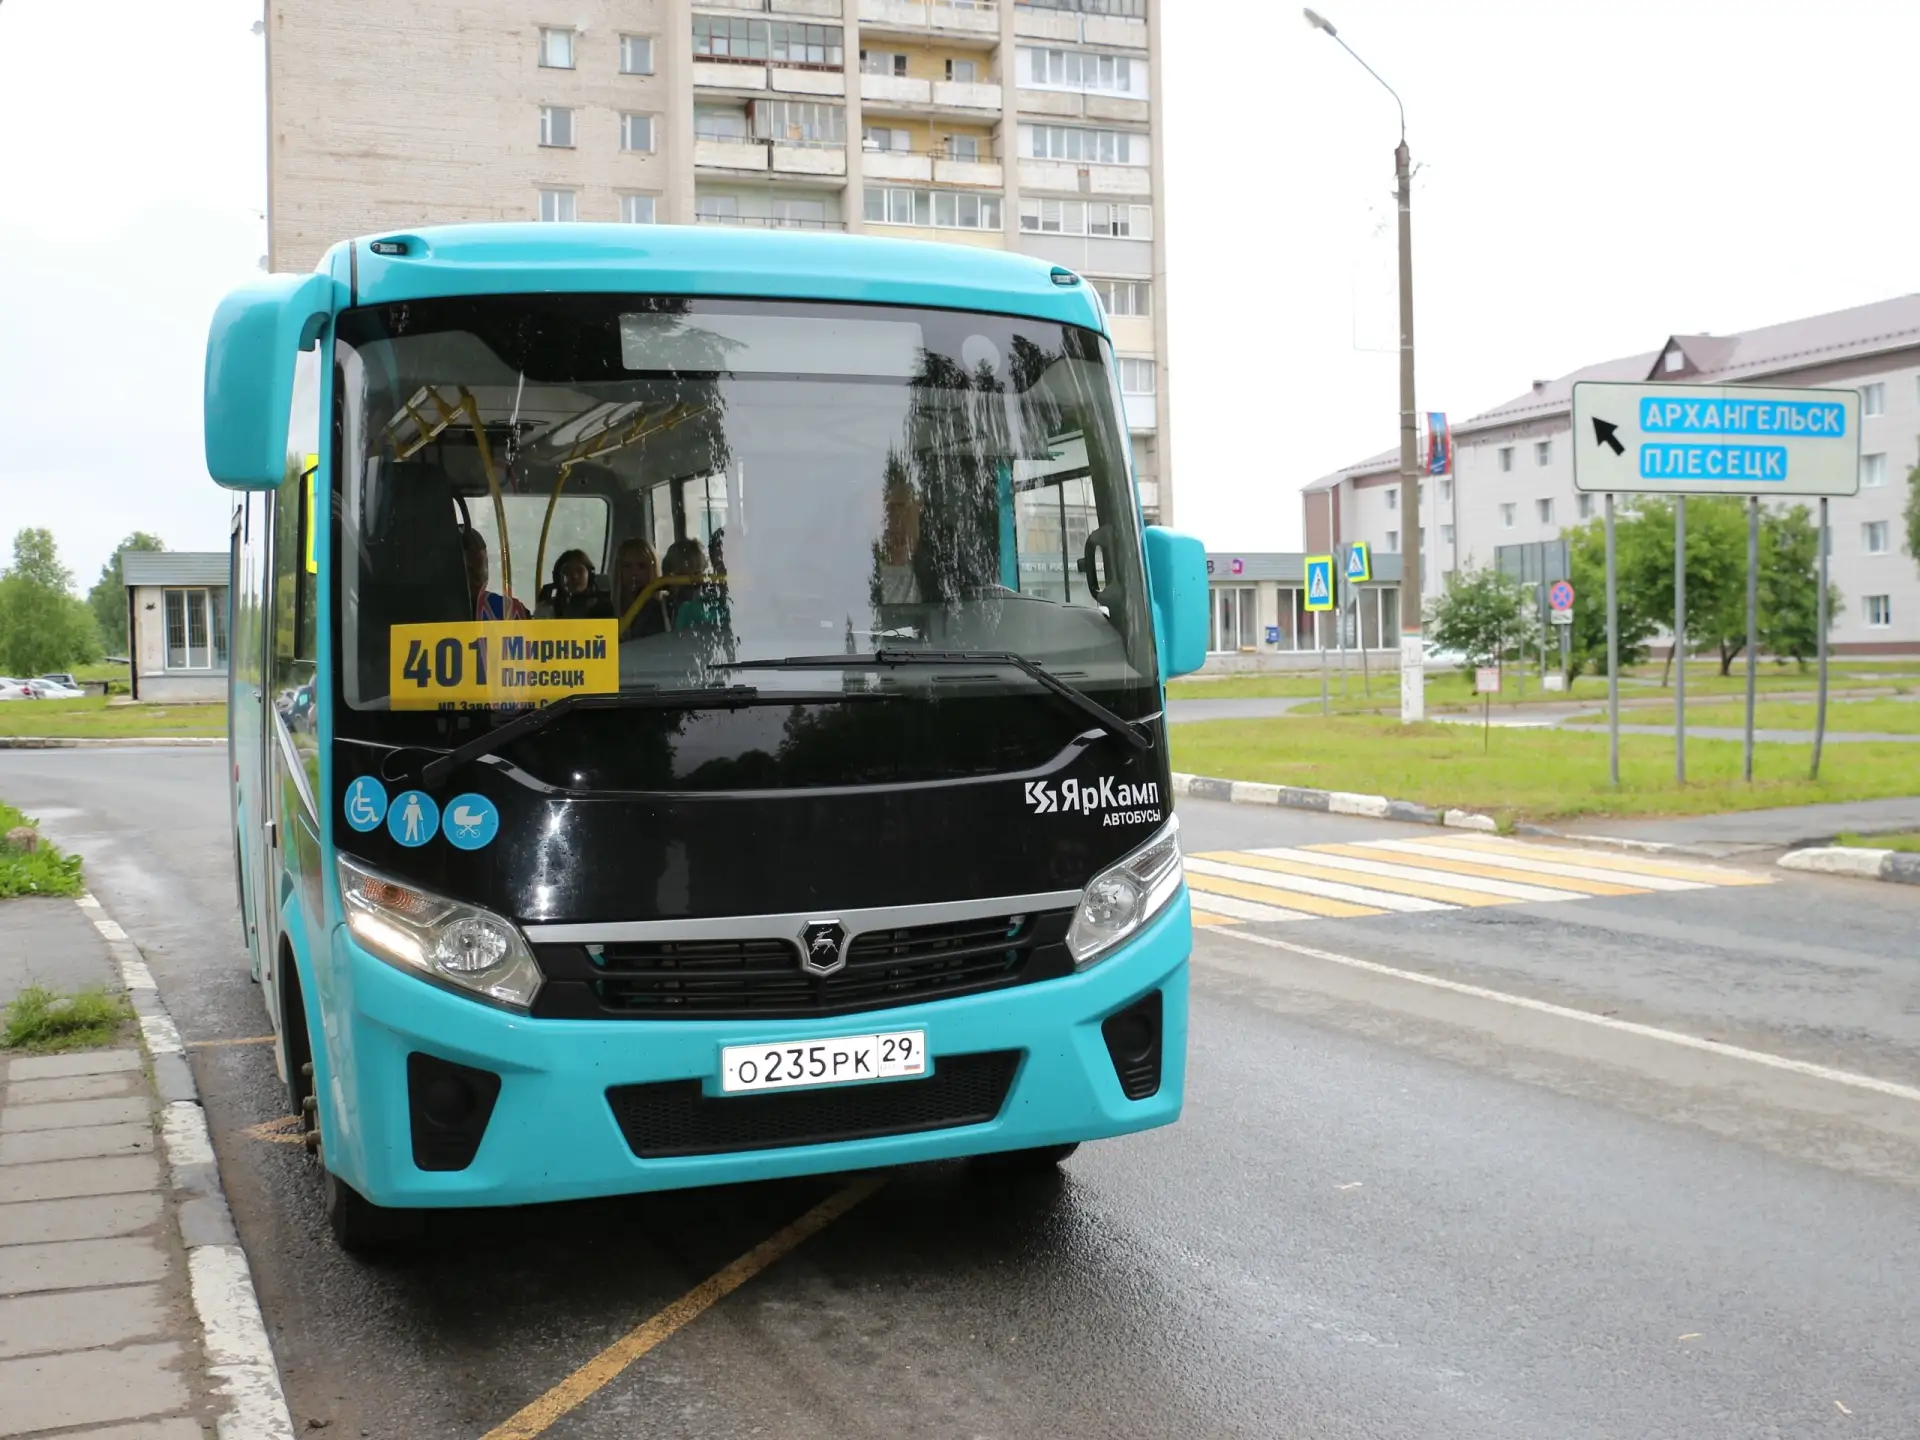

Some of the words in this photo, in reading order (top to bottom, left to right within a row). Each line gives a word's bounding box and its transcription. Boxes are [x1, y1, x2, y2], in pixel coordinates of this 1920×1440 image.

[1646, 403, 1840, 432] АРХАНГЕЛЬСК
[1644, 449, 1782, 477] ПЛЕСЕЦК
[403, 637, 488, 688] 401
[502, 635, 606, 662] Мирный
[502, 667, 585, 688] Плесецк
[1061, 776, 1159, 815] ЯрКамп
[1103, 809, 1161, 826] АВТОБУСЫ
